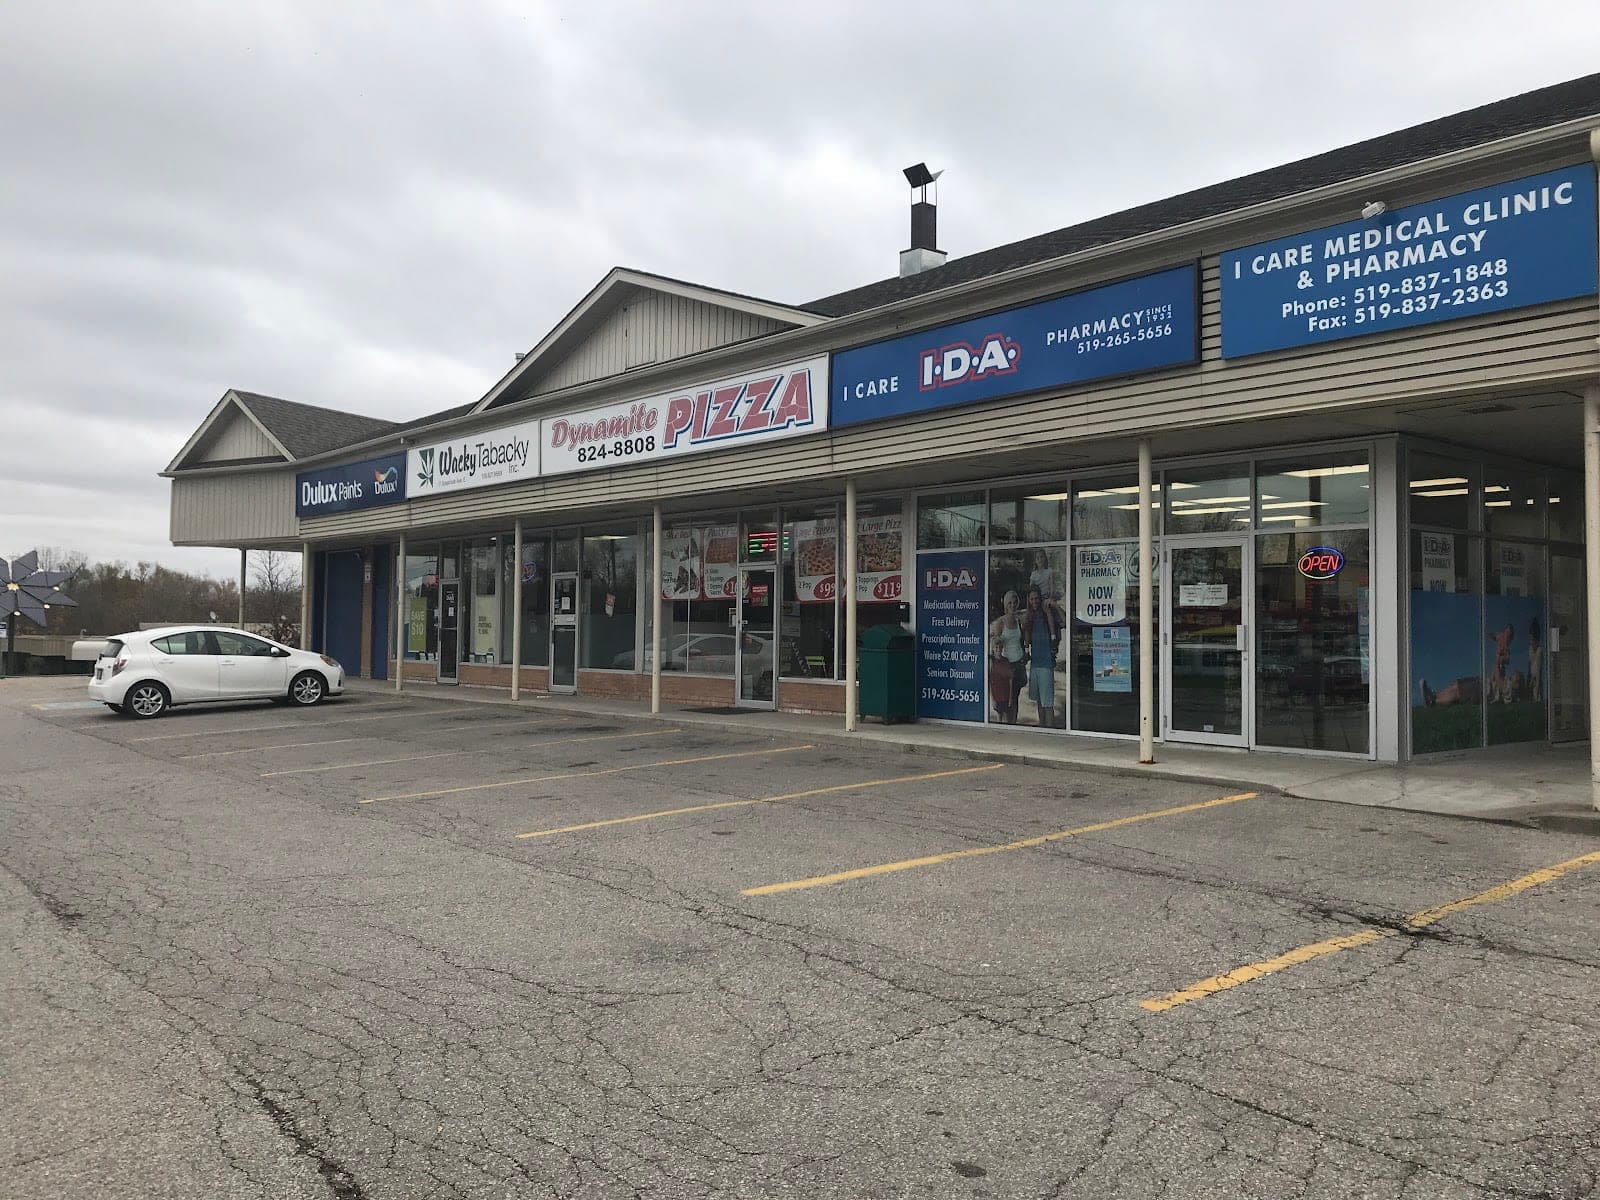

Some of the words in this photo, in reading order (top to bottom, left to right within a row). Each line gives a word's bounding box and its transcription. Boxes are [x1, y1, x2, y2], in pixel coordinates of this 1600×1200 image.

[1234, 260, 1241, 279] I
[1251, 244, 1313, 275] CARE
[1323, 212, 1449, 259] MEDICAL
[1462, 181, 1573, 227] CLINIC
[1297, 270, 1313, 290] &
[1326, 229, 1487, 283] PHARMACY
[1282, 294, 1346, 318] Phone:
[1354, 258, 1508, 304] 519-837-1848
[1145, 303, 1173, 317] SINCE
[1308, 314, 1347, 332] Fax:
[1354, 280, 1509, 324] 519-837-2363
[1146, 311, 1173, 323] 1932
[1046, 309, 1145, 346] PHARMACY
[1076, 323, 1172, 355] 519-265-5656
[843, 386, 848, 401] I
[855, 375, 899, 399] CARE
[662, 367, 814, 450] PIZZA
[551, 402, 659, 450] Dynamite
[577, 436, 655, 463] 824-8808
[302, 481, 337, 507] Dulux
[338, 481, 363, 501] Paints
[374, 480, 396, 495] Dulux
[1301, 554, 1339, 572] OPEN
[1424, 558, 1451, 569] PHARMACY
[1081, 567, 1122, 578] PHARMACY
[1088, 586, 1114, 600] NOW
[923, 600, 954, 610] Medication
[956, 600, 979, 610] Reviews
[1087, 604, 1115, 617] OPEN
[411, 610, 425, 621] SAVE
[931, 616, 945, 627] Free
[945, 616, 970, 629] Delivery
[411, 623, 424, 635] $10
[921, 633, 955, 645] Prescription
[957, 633, 980, 645] Transfer
[924, 650, 941, 661] Waive
[942, 651, 959, 661] $2.00
[960, 651, 978, 664] CoPay
[927, 667, 948, 678] Seniors
[949, 668, 974, 680] Discount
[922, 687, 980, 703] 519-265-5656
